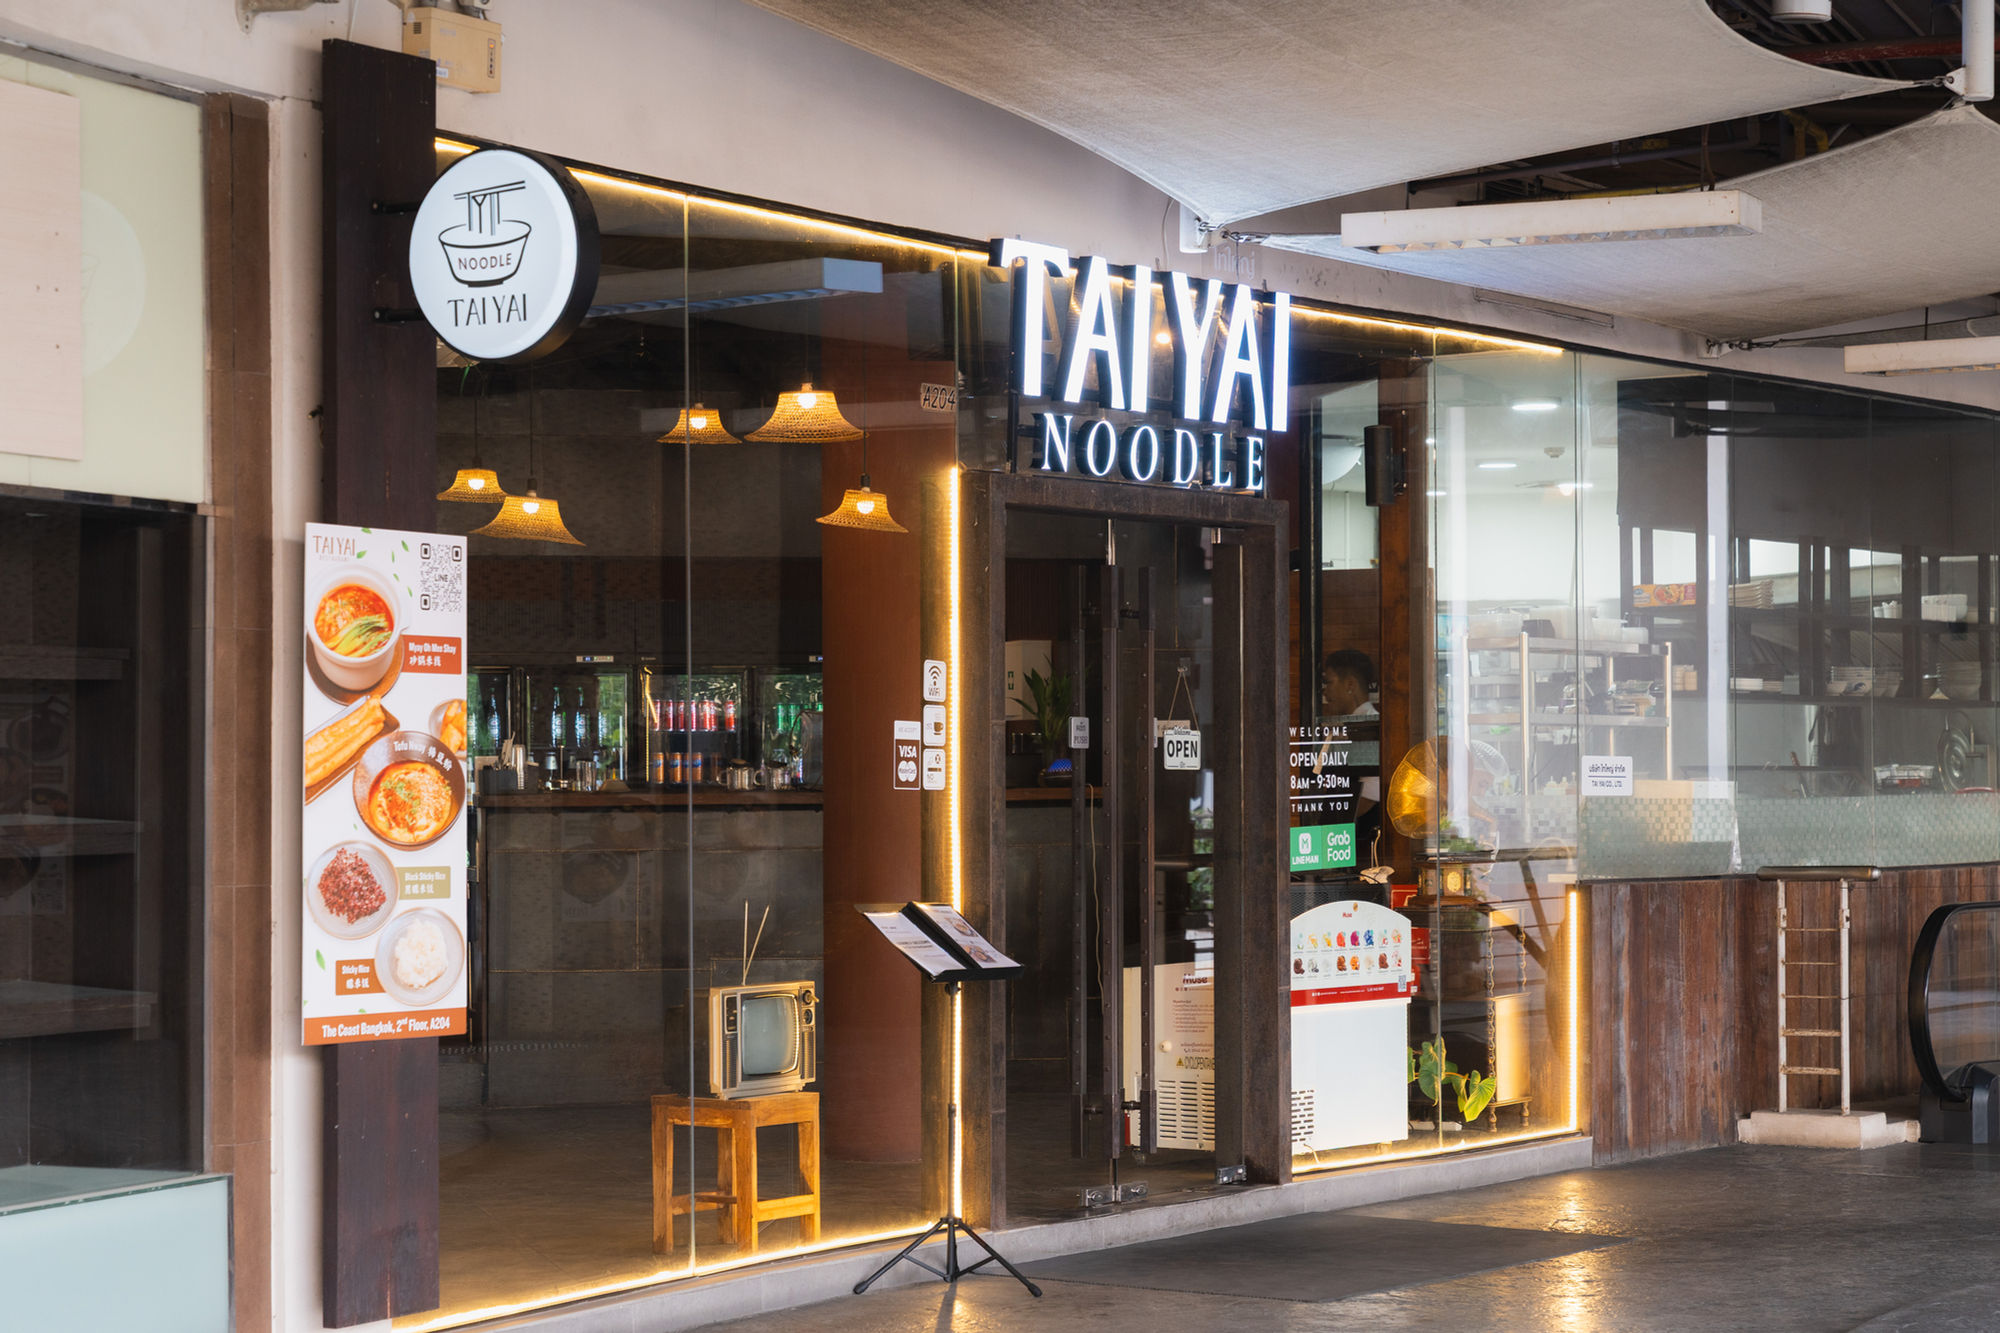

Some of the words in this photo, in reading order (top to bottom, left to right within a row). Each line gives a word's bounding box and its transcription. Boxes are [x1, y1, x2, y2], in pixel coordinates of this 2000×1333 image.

[457, 252, 513, 271] NOODLE
[922, 386, 956, 411] A204
[1040, 411, 1264, 491] NOODLE
[1288, 726, 1348, 738] WELCOME
[898, 745, 917, 758] VISA
[1166, 739, 1198, 758] OPEN
[1289, 752, 1318, 767] OPEN
[1321, 751, 1349, 766] DAILY
[1291, 802, 1324, 813] THANK
[1329, 801, 1350, 812] YOU
[1327, 830, 1351, 846] Grab
[1327, 846, 1351, 862] Food
[321, 1024, 337, 1039] The
[337, 1023, 360, 1037] Coast
[360, 1020, 396, 1037] Bangkok,
[408, 1018, 430, 1033] Floor,
[429, 1016, 451, 1031] A204
